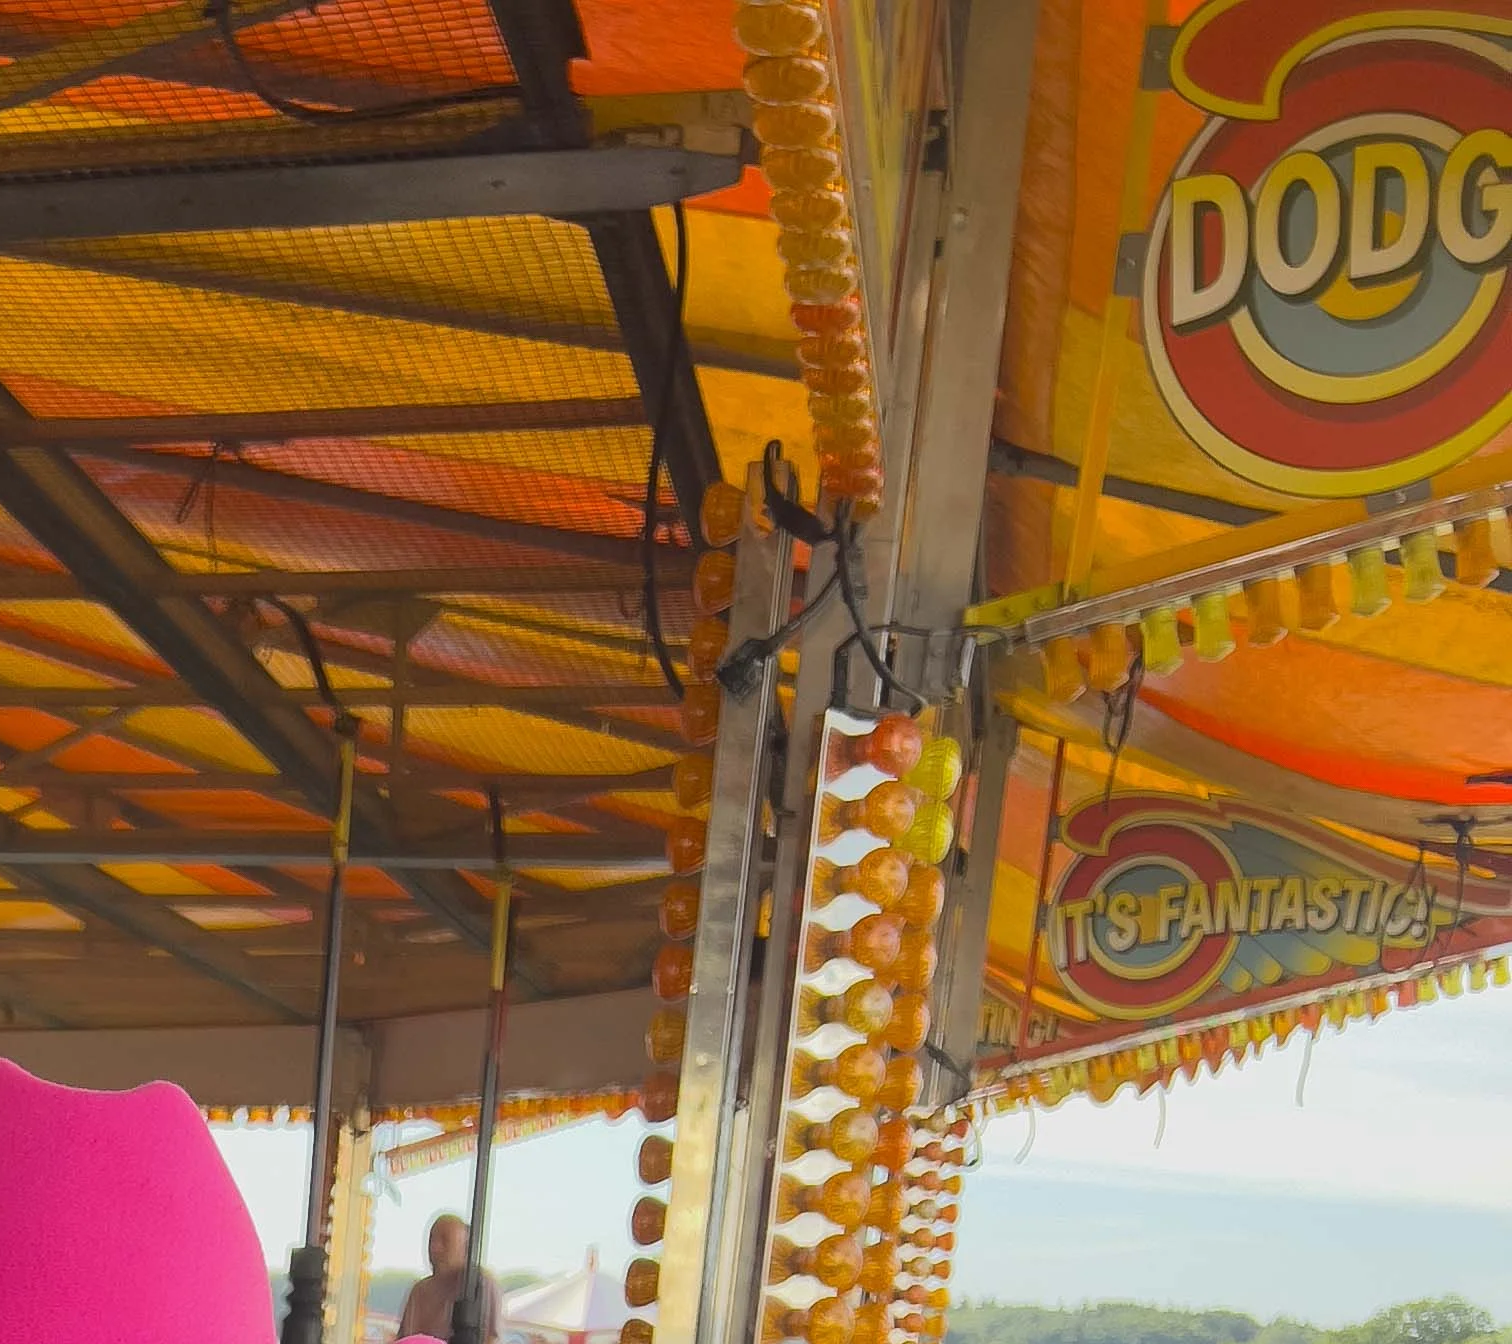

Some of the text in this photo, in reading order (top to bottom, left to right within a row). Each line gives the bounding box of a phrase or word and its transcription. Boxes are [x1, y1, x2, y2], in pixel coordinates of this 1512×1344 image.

[1172, 130, 1512, 328] DODG
[1056, 877, 1431, 968] IT'S FANTASTIC!
